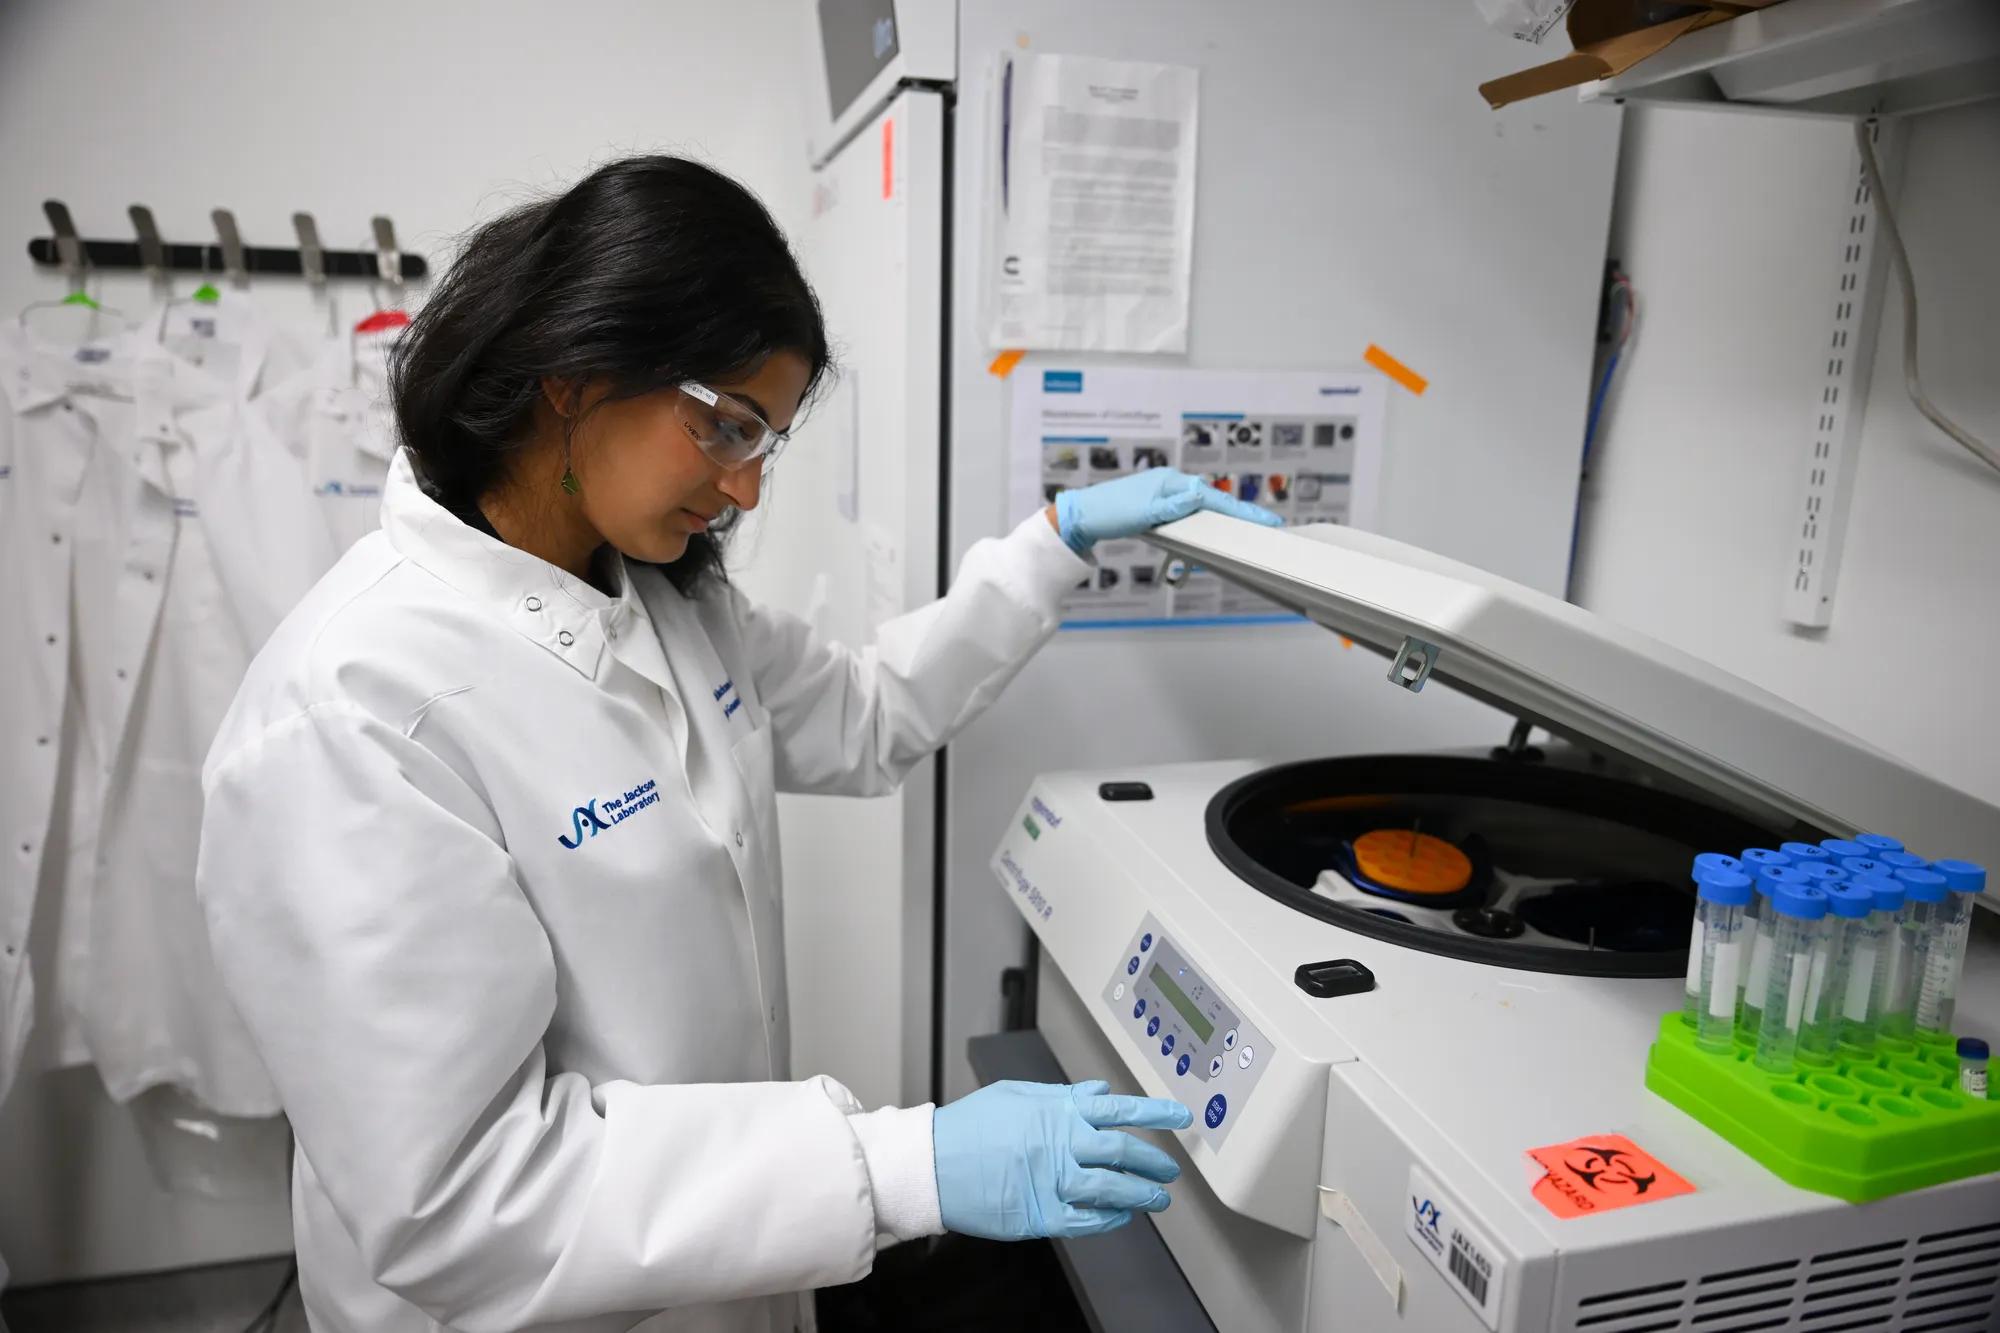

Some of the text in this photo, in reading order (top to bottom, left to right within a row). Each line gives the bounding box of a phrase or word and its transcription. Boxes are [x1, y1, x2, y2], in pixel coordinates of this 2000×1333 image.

[602, 779, 656, 813] The Jackson
[610, 791, 660, 824] Laboratory
[1207, 1108, 1218, 1123] stop
[1212, 1100, 1223, 1115] start
